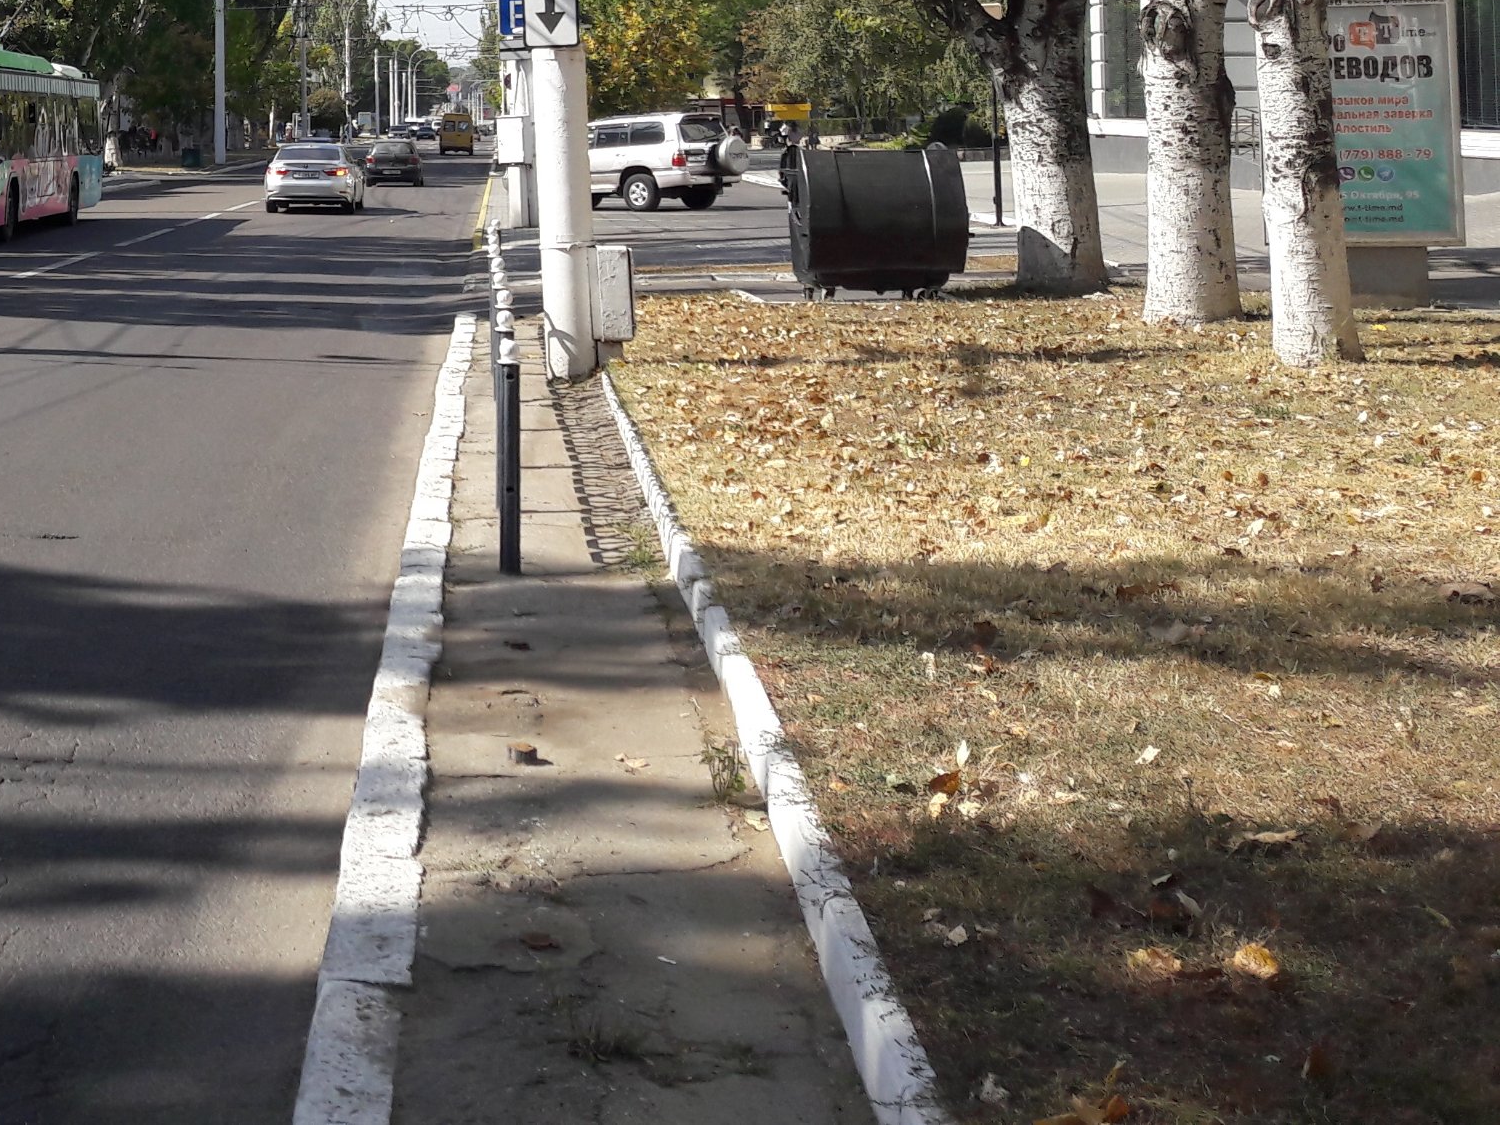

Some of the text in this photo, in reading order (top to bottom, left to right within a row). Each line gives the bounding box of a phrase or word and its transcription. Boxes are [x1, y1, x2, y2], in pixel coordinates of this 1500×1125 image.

[1377, 95, 1409, 107] мира
[1383, 109, 1433, 120] заверка
[1335, 122, 1392, 133] Апостиль
[1339, 149, 1374, 161] (779)
[1378, 149, 1403, 160] 888
[1415, 148, 1432, 160] 79
